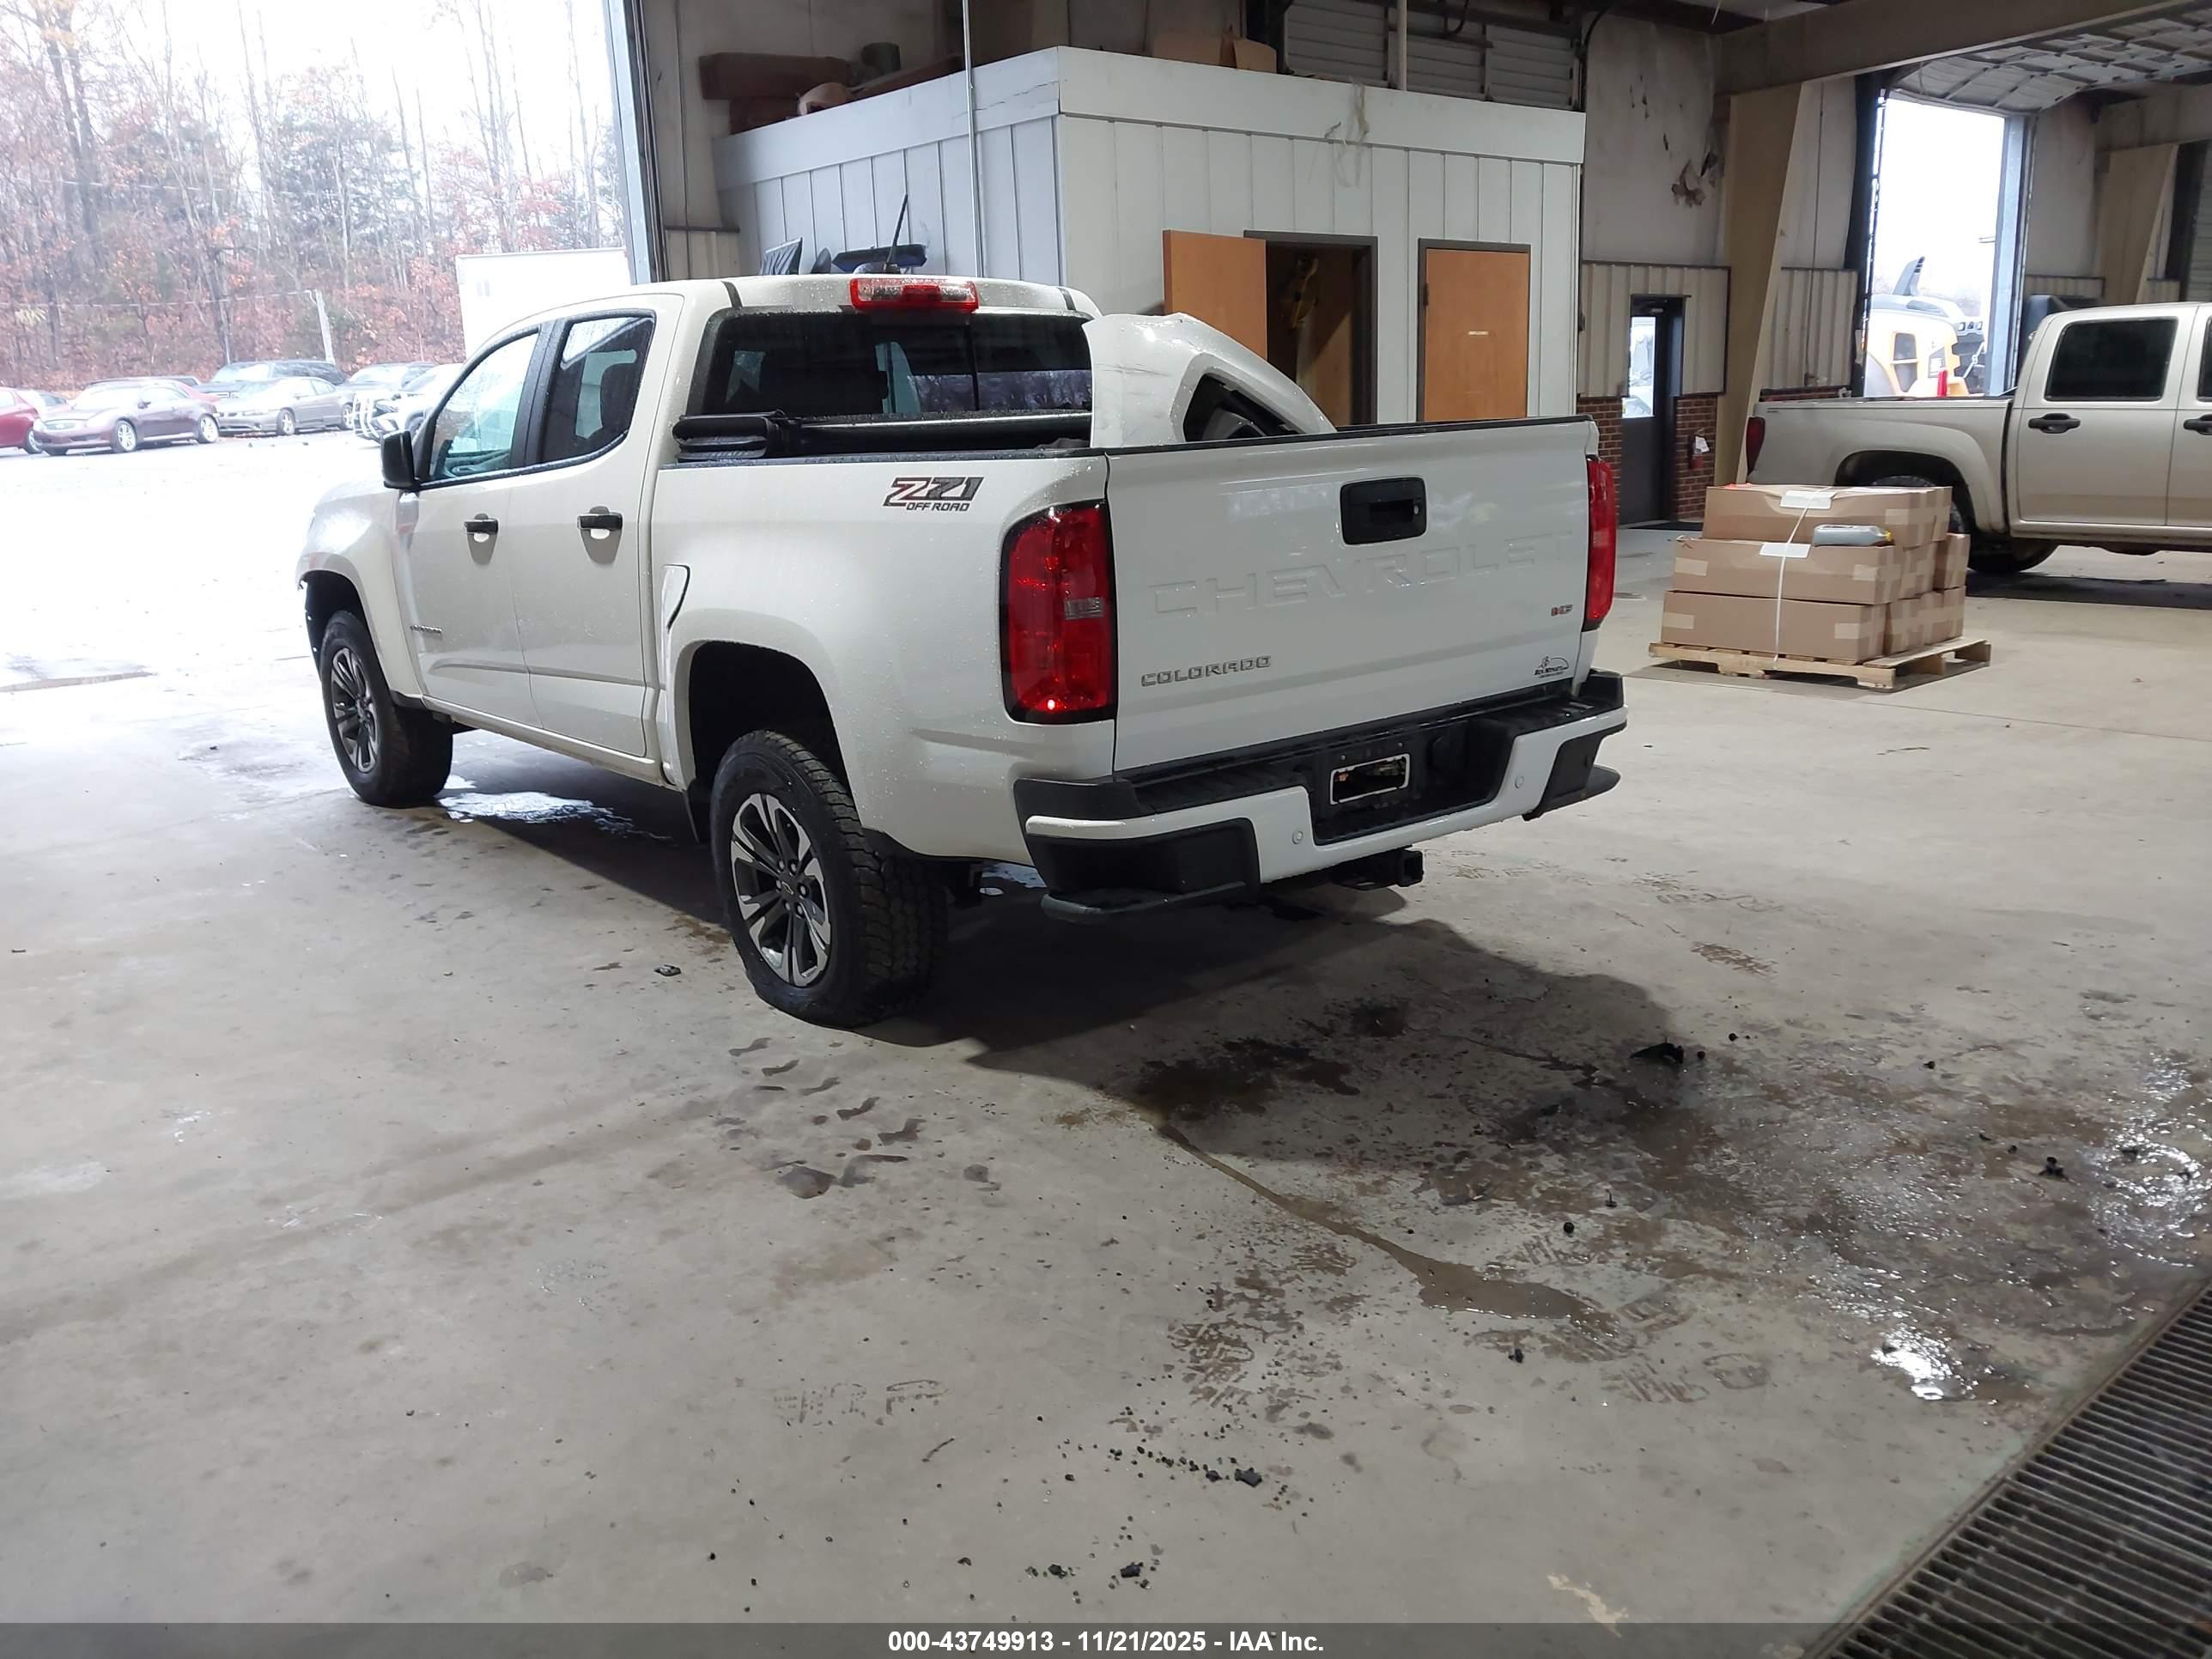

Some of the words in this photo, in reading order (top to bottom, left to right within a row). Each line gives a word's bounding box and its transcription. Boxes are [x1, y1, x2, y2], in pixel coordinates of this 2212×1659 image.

[883, 477, 984, 507] Z71
[907, 501, 931, 511] OFF
[933, 502, 970, 512] ROAD
[1148, 530, 1573, 620] CHEVROLET
[1140, 655, 1272, 687] COLORADO
